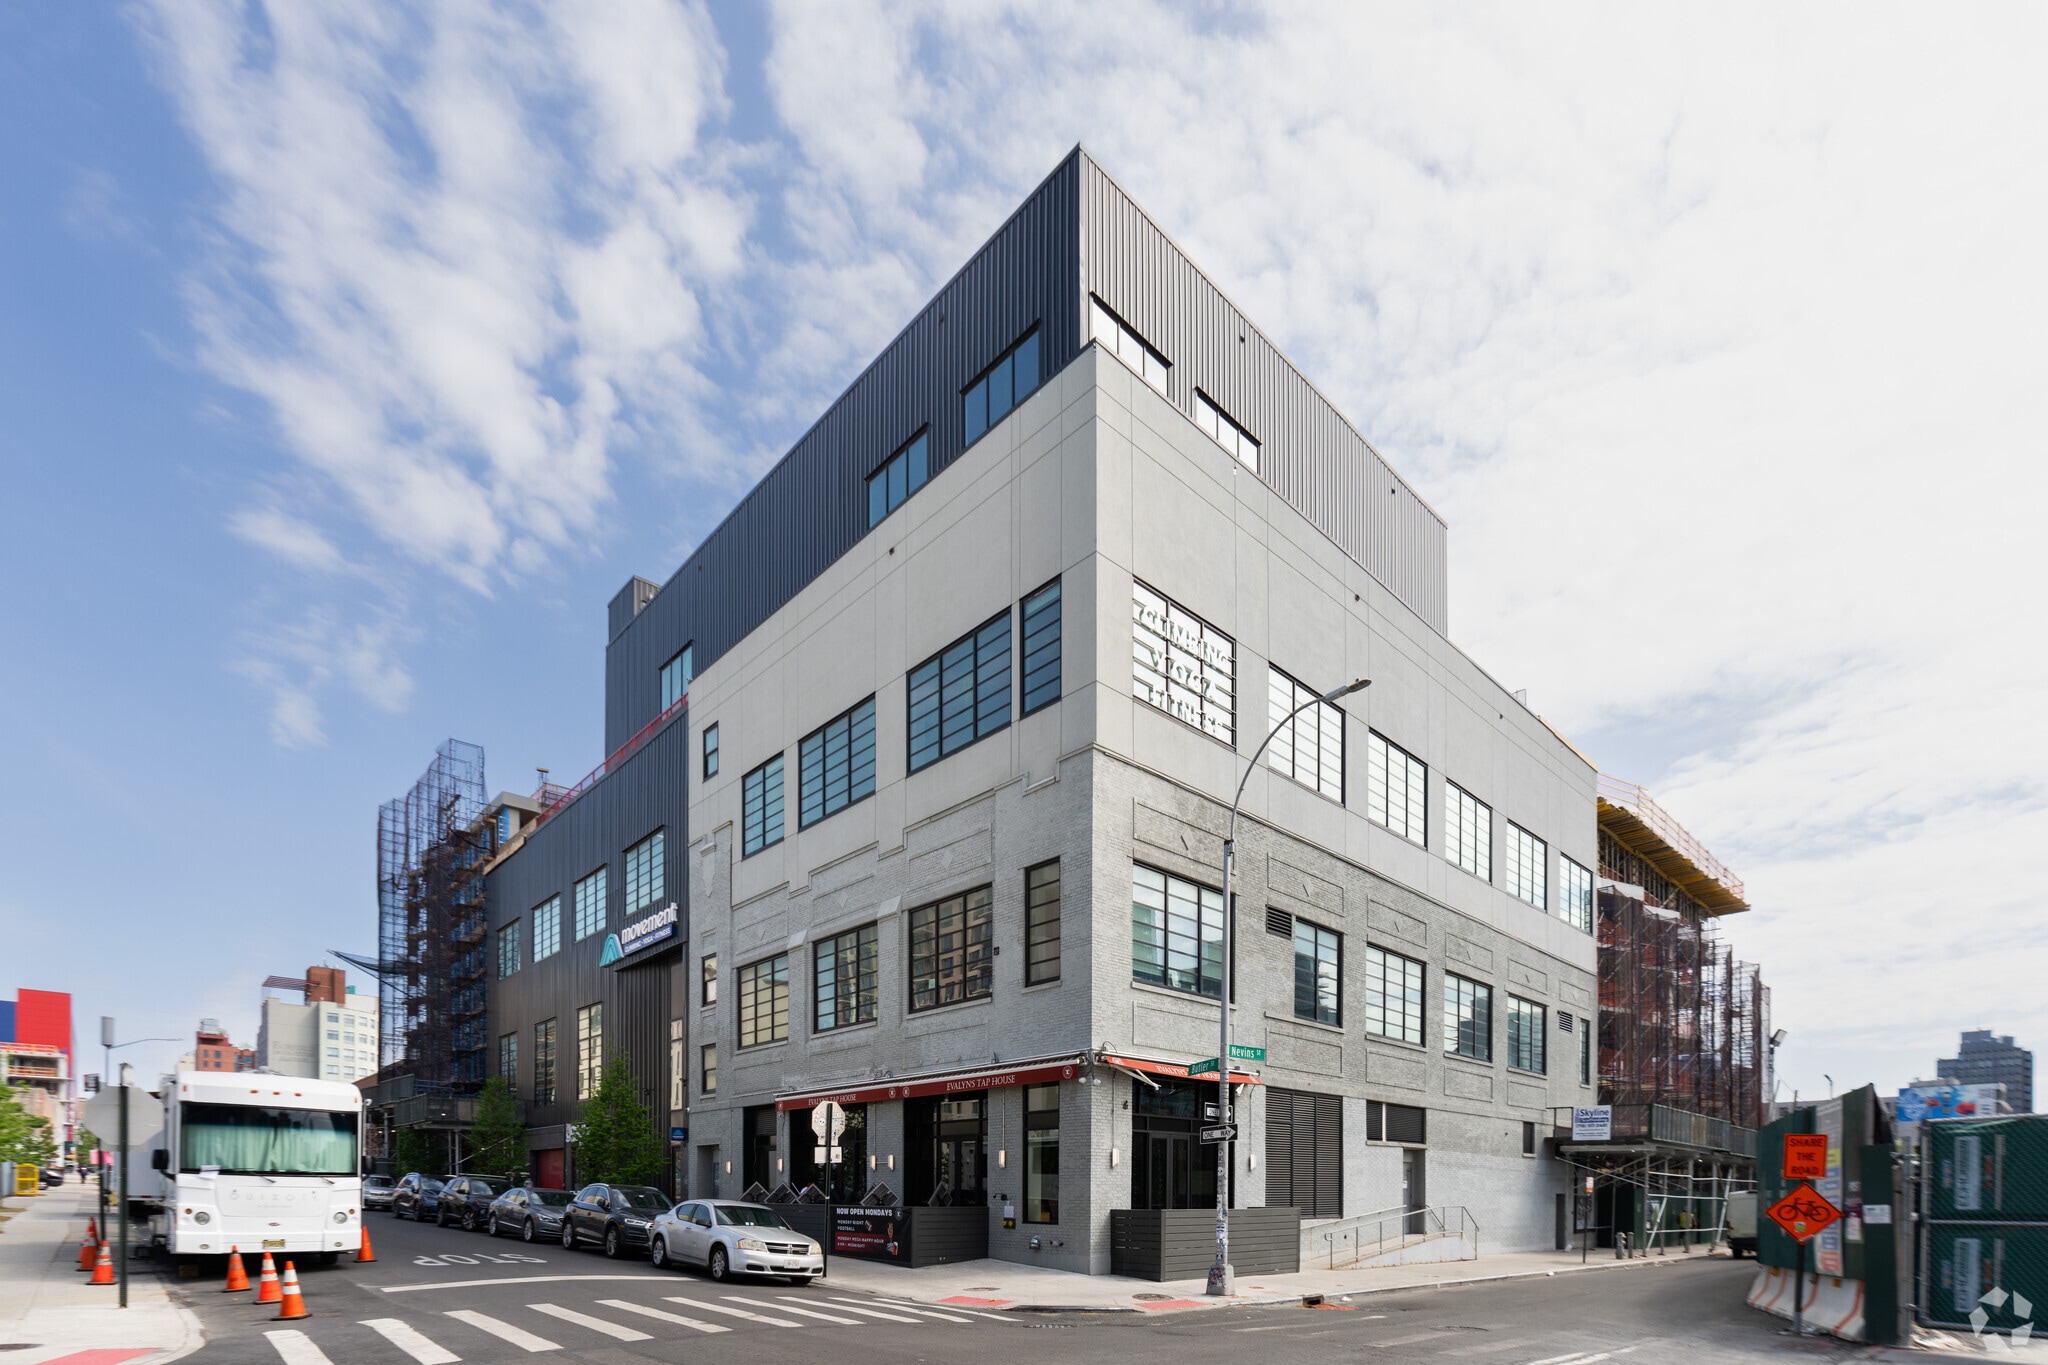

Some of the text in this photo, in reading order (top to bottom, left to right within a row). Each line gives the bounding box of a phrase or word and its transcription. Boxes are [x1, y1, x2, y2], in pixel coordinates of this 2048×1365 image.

[1141, 603, 1230, 674] CLIMBING
[1153, 646, 1217, 702] YOGA
[621, 902, 678, 945] movement
[1231, 1046, 1255, 1058] Nevins
[1191, 1062, 1209, 1075] Butler
[977, 1077, 991, 1088] TAP
[992, 1074, 1016, 1086] HOUSE
[839, 1093, 857, 1102] HOUSE
[1580, 1109, 1609, 1118] Skyline
[1204, 1129, 1231, 1139] ONE WAY
[1790, 1137, 1824, 1147] SHARE
[1796, 1151, 1816, 1161] THE
[1791, 1165, 1819, 1175] ROAD
[836, 1207, 849, 1215] NOW
[850, 1208, 864, 1216] OPEN
[865, 1208, 893, 1217] MONDAYS
[413, 1253, 548, 1266] STOP
